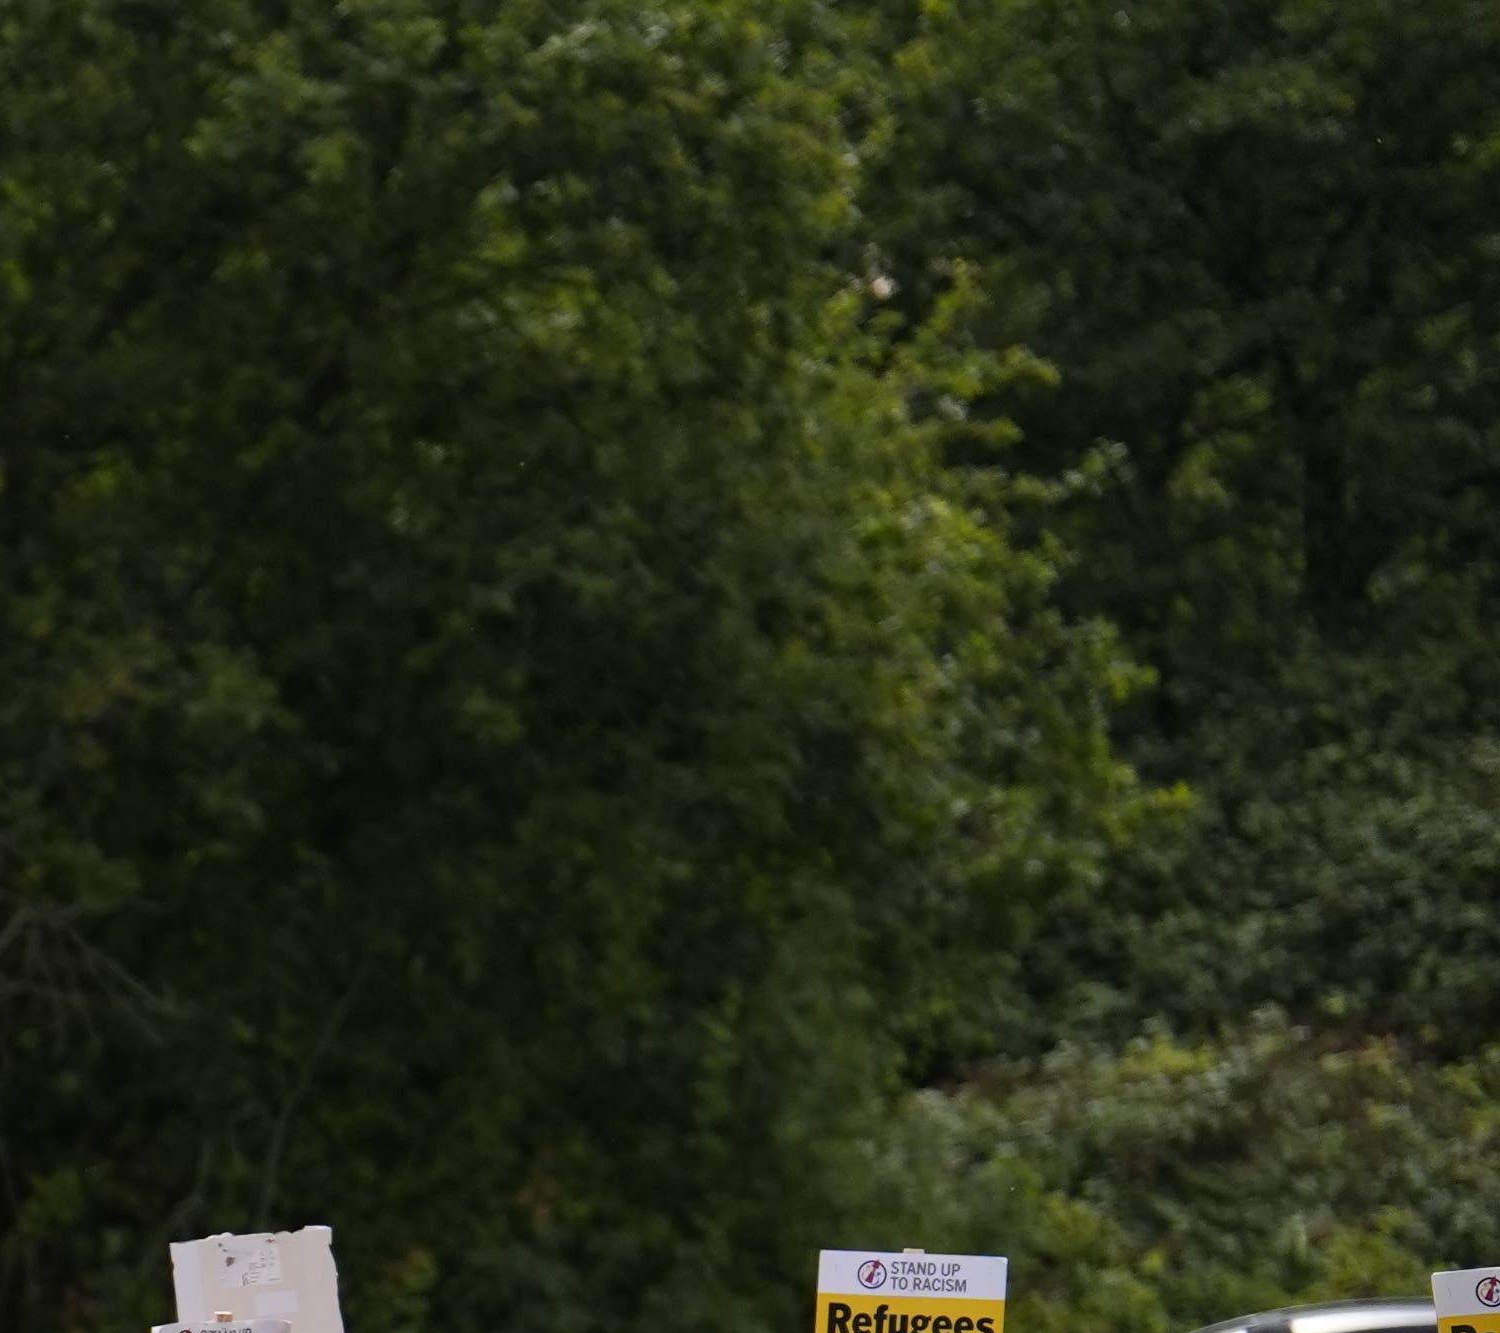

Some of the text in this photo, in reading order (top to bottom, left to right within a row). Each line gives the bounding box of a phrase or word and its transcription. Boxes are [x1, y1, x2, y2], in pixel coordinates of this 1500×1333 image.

[891, 1261, 960, 1277] STAND UP
[891, 1277, 967, 1292] TO RACISM
